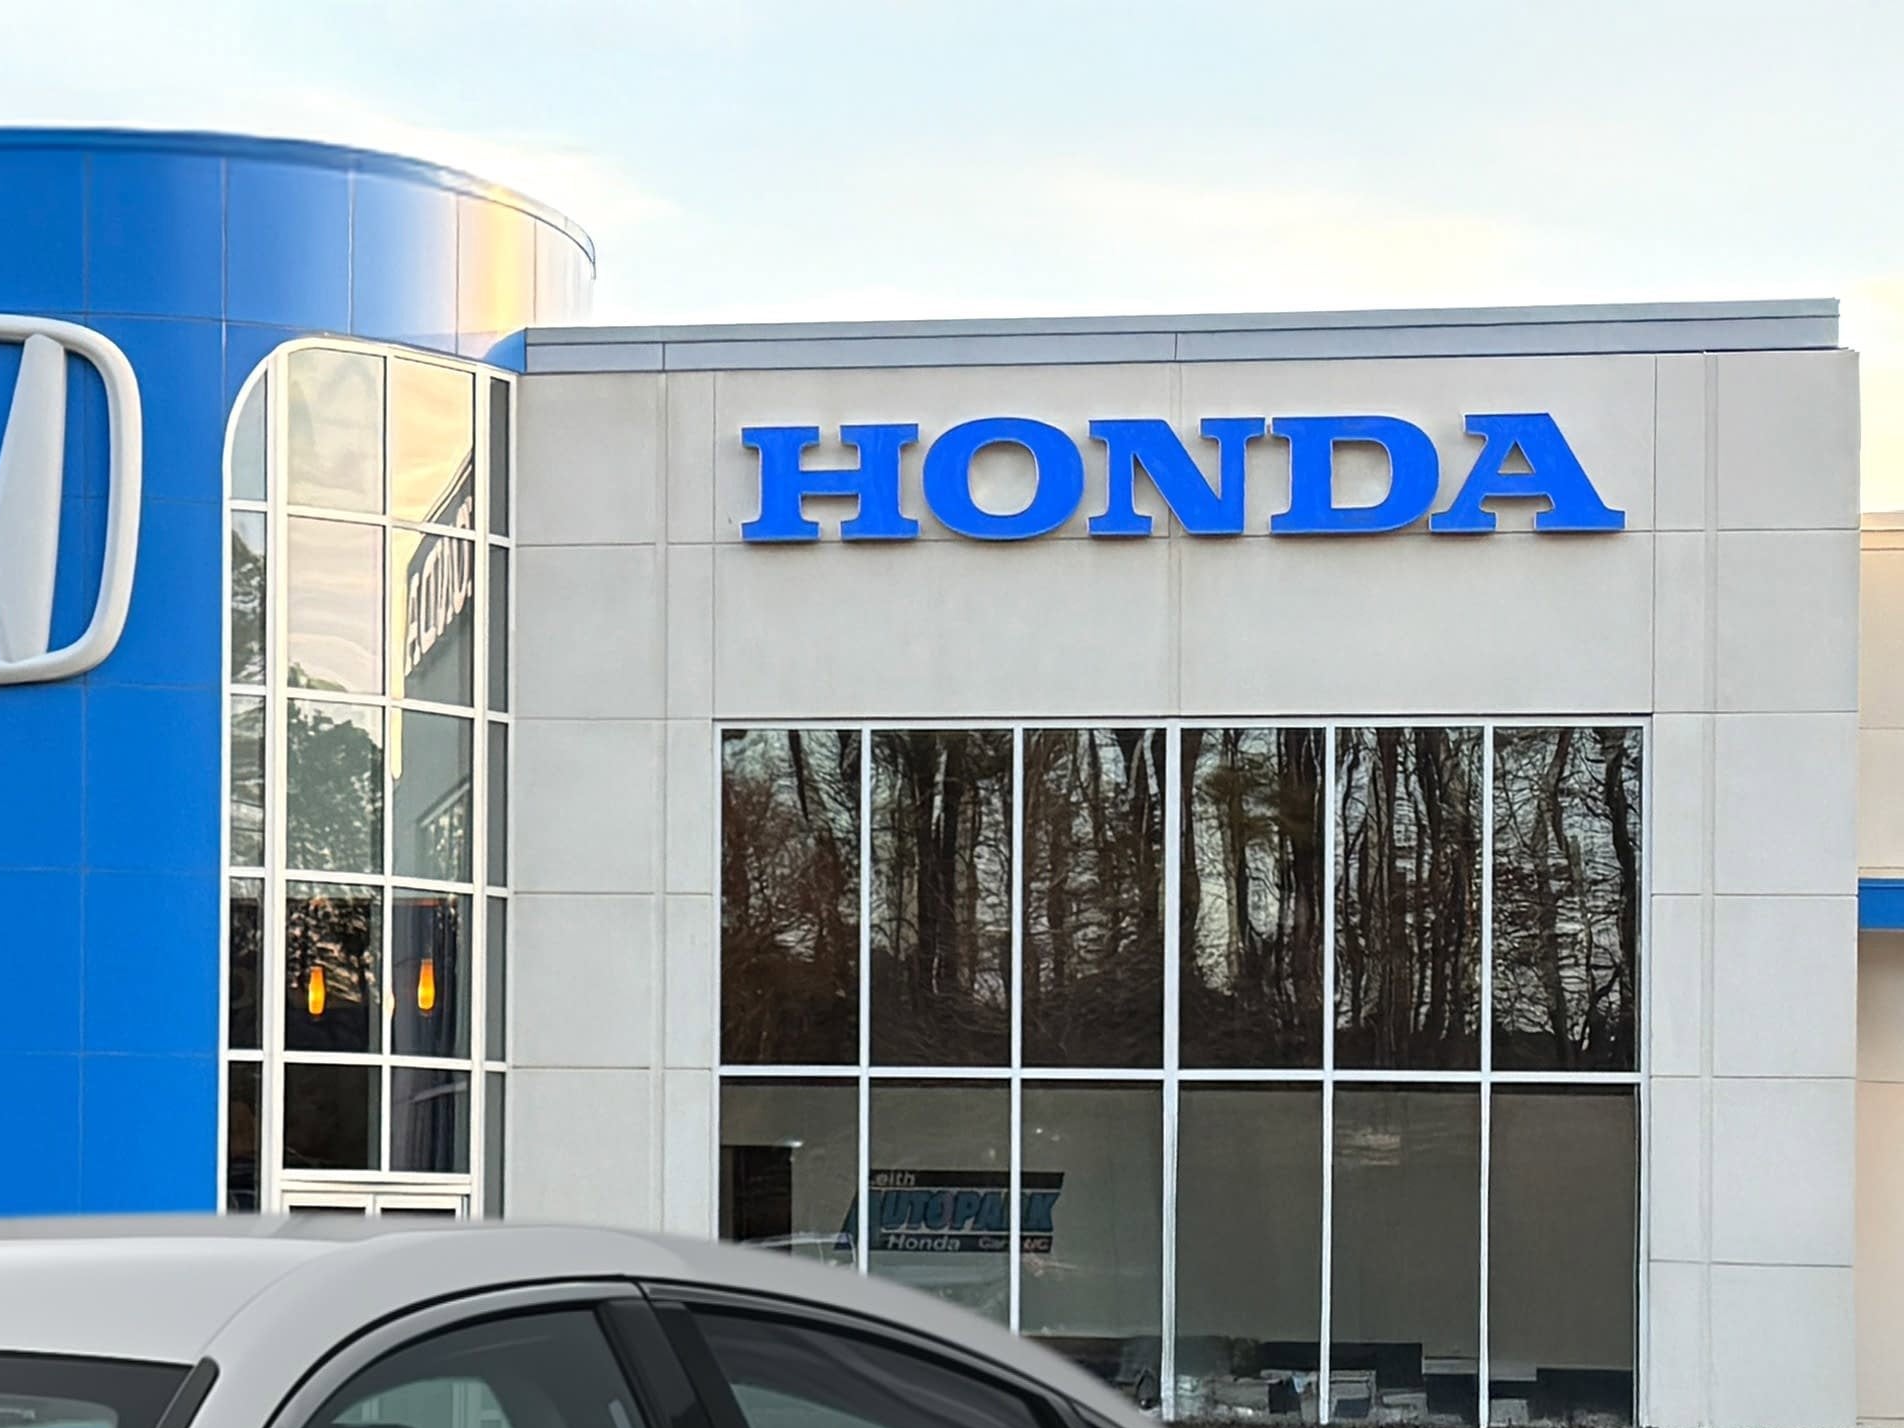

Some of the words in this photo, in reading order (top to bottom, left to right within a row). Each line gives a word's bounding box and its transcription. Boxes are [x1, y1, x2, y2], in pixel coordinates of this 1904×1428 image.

[739, 412, 1627, 542] HONDA
[871, 1171, 917, 1187] eith
[887, 1234, 961, 1250] Honda
